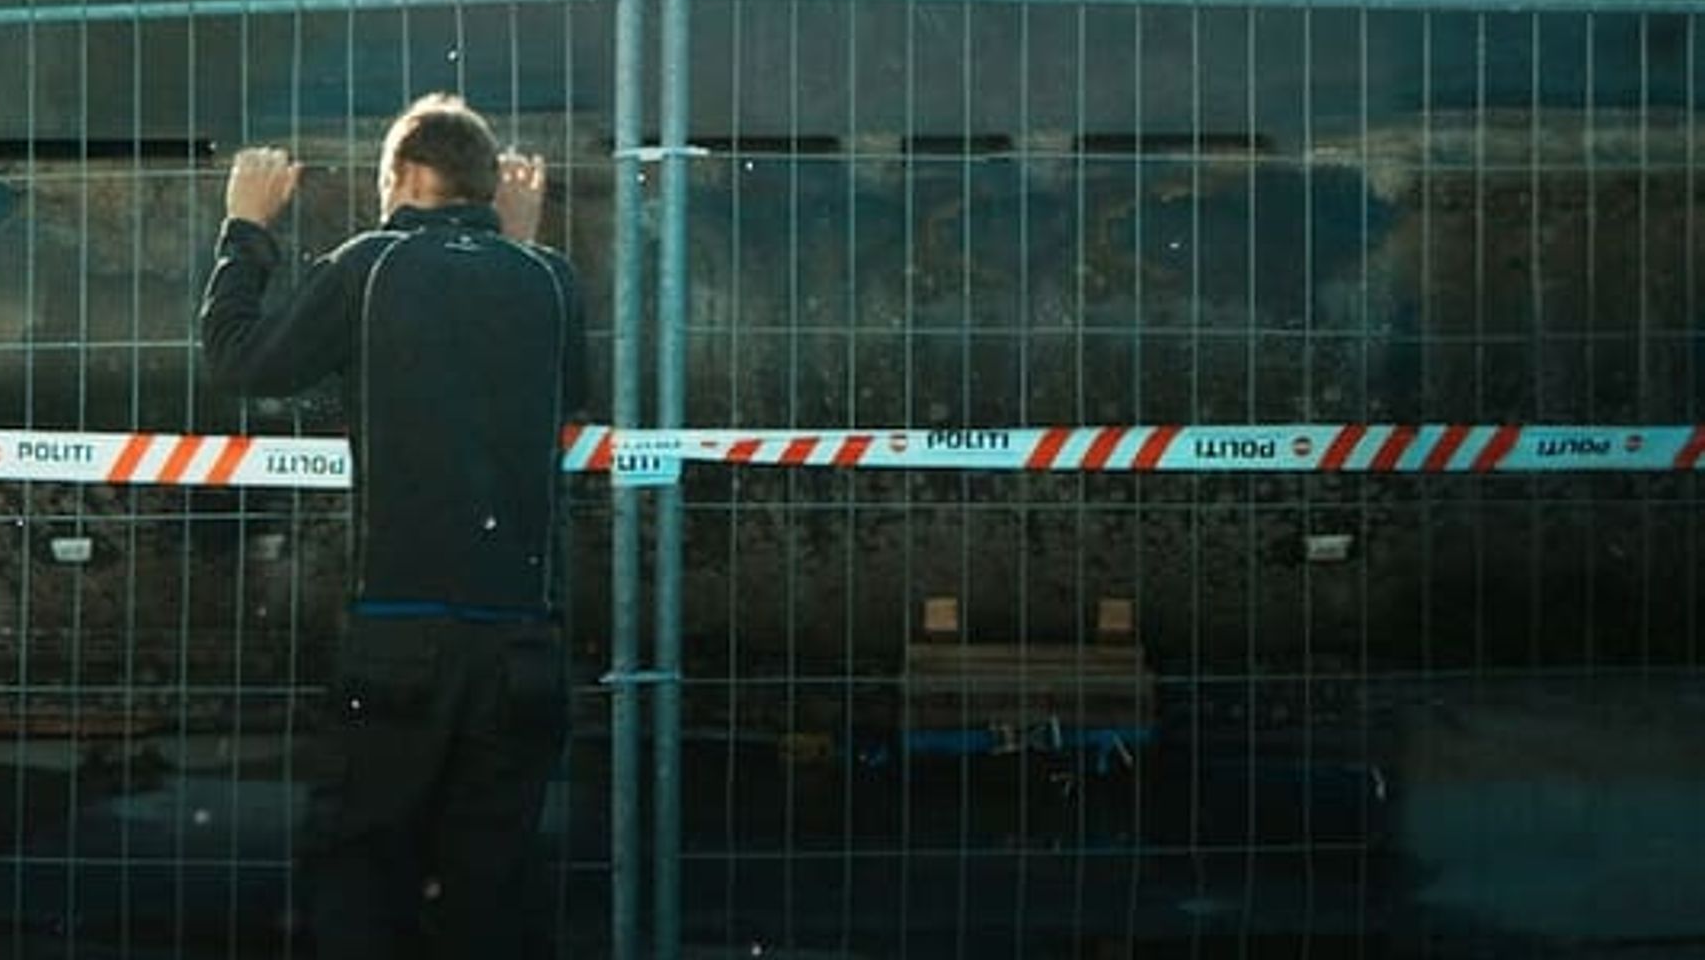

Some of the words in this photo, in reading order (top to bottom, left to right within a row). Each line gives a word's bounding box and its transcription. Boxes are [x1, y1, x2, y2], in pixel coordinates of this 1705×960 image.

[926, 430, 1010, 449] POLITI
[1195, 439, 1275, 458] POLITI
[17, 441, 94, 463] POLITI
[266, 453, 345, 474] POLITI
